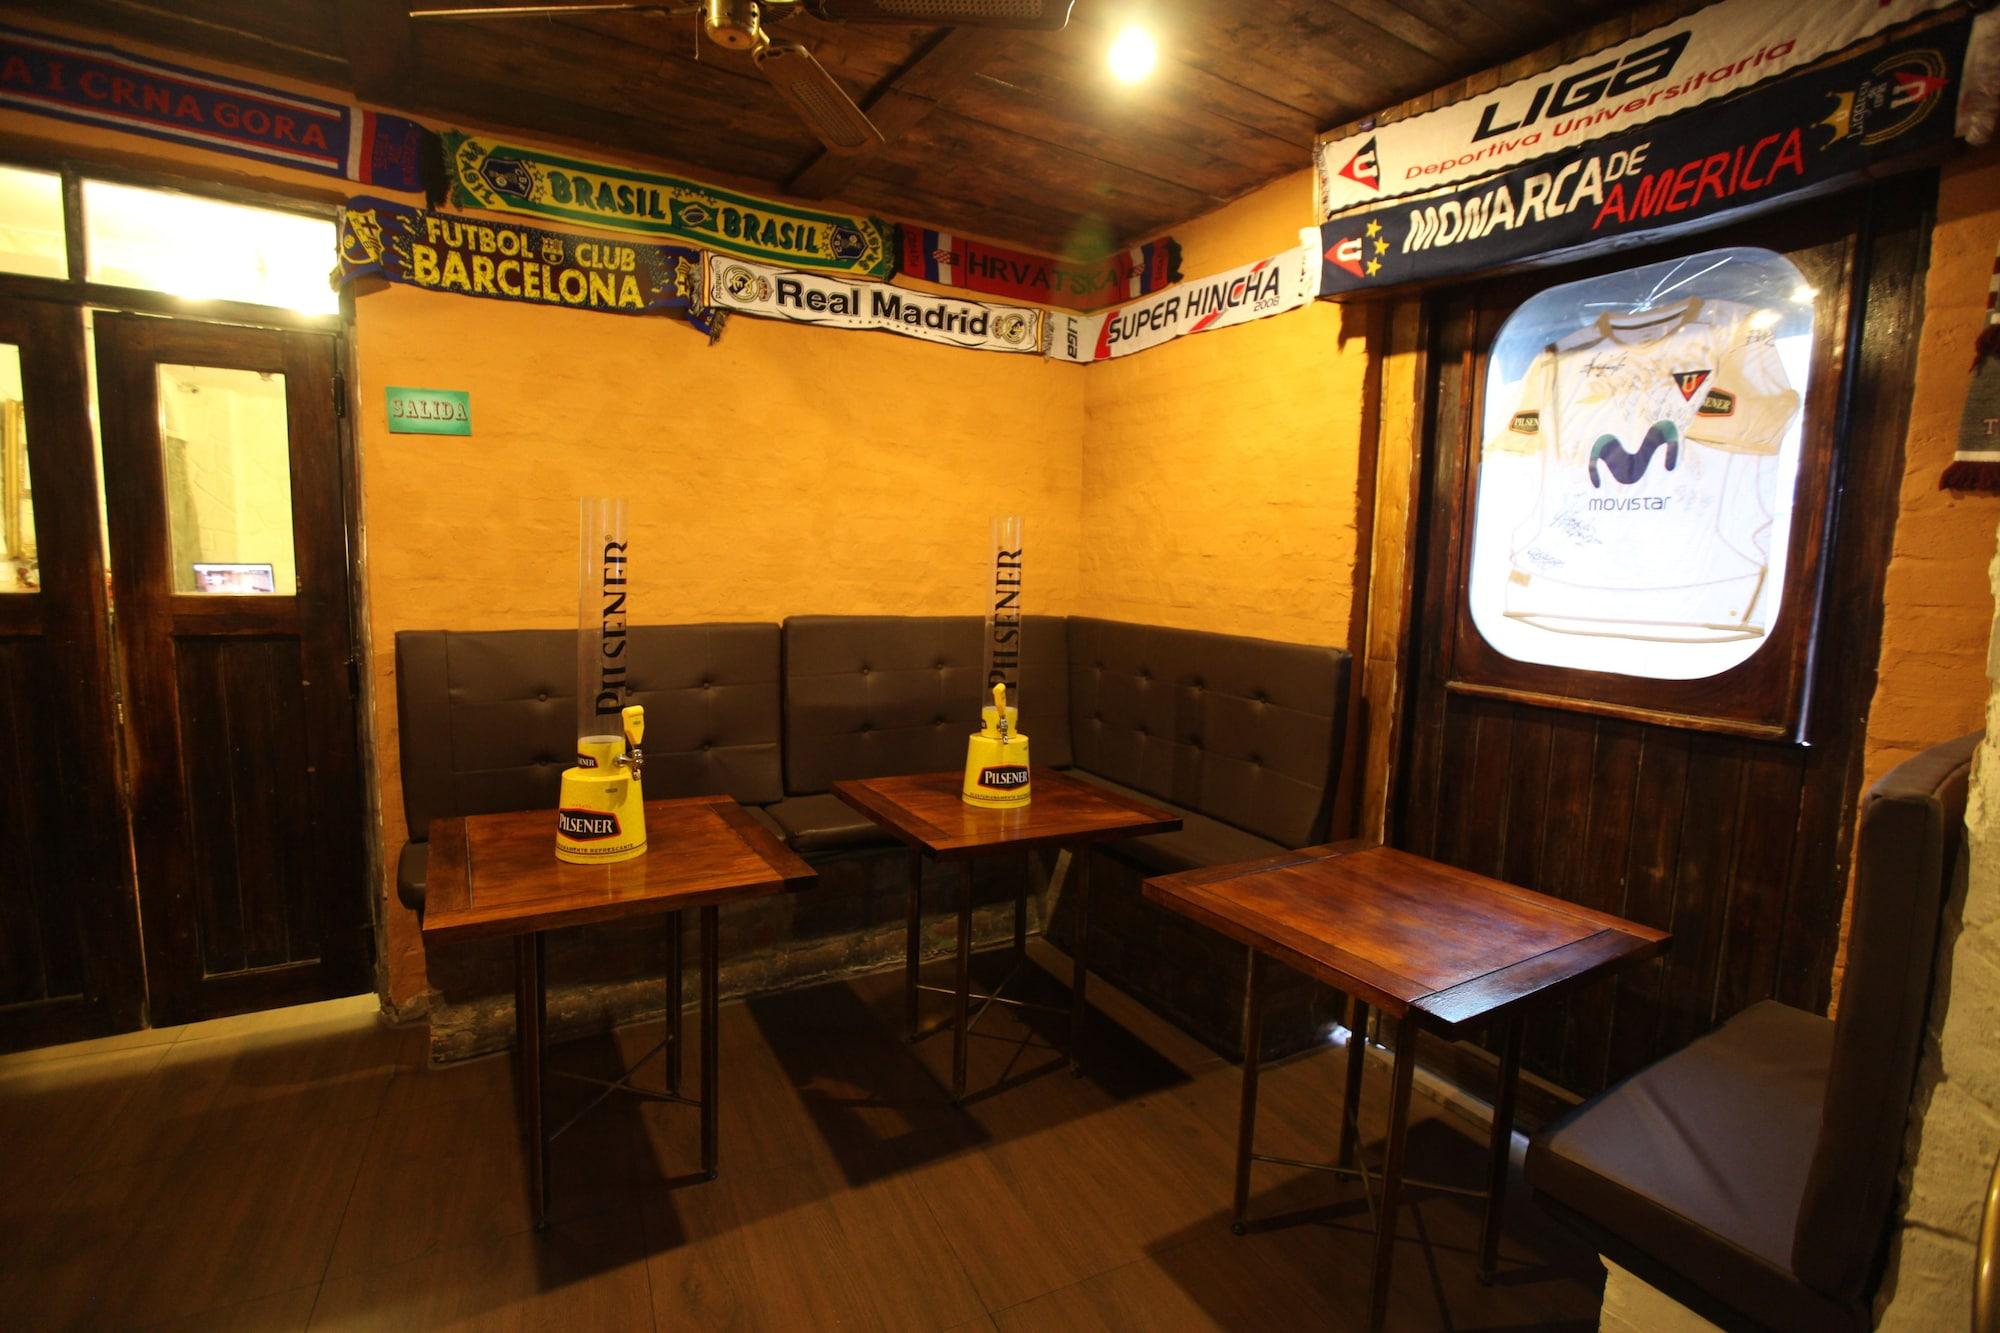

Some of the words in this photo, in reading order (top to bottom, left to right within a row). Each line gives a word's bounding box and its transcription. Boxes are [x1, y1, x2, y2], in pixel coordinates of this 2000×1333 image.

[79, 70, 203, 122] CRNA
[214, 102, 328, 149] GORA
[1405, 132, 1541, 179] Deportiva
[1553, 38, 1796, 137] Universitaria
[547, 170, 666, 220] BRASIL
[1402, 156, 1603, 253] MONARCA
[1603, 142, 1650, 182] DE
[1592, 128, 1805, 230] AMERICA
[425, 216, 534, 259] FUTBOL
[574, 242, 636, 272] CLUB
[722, 206, 819, 254] BRASIL
[412, 243, 645, 309] BARCELONA
[968, 251, 1118, 295] HRVATSKA
[775, 275, 861, 317] Real
[871, 289, 990, 336] Madrid
[1107, 296, 1181, 344] SUPER
[1184, 267, 1279, 319] HINCHA
[1253, 296, 1280, 312] 2008
[392, 399, 468, 422] SALIDA
[1588, 496, 1671, 511] movistar
[596, 539, 627, 716] PILSENER
[988, 548, 1022, 689] PILSENER
[985, 770, 1028, 784] PILSENER
[559, 812, 613, 834] PILSENER
